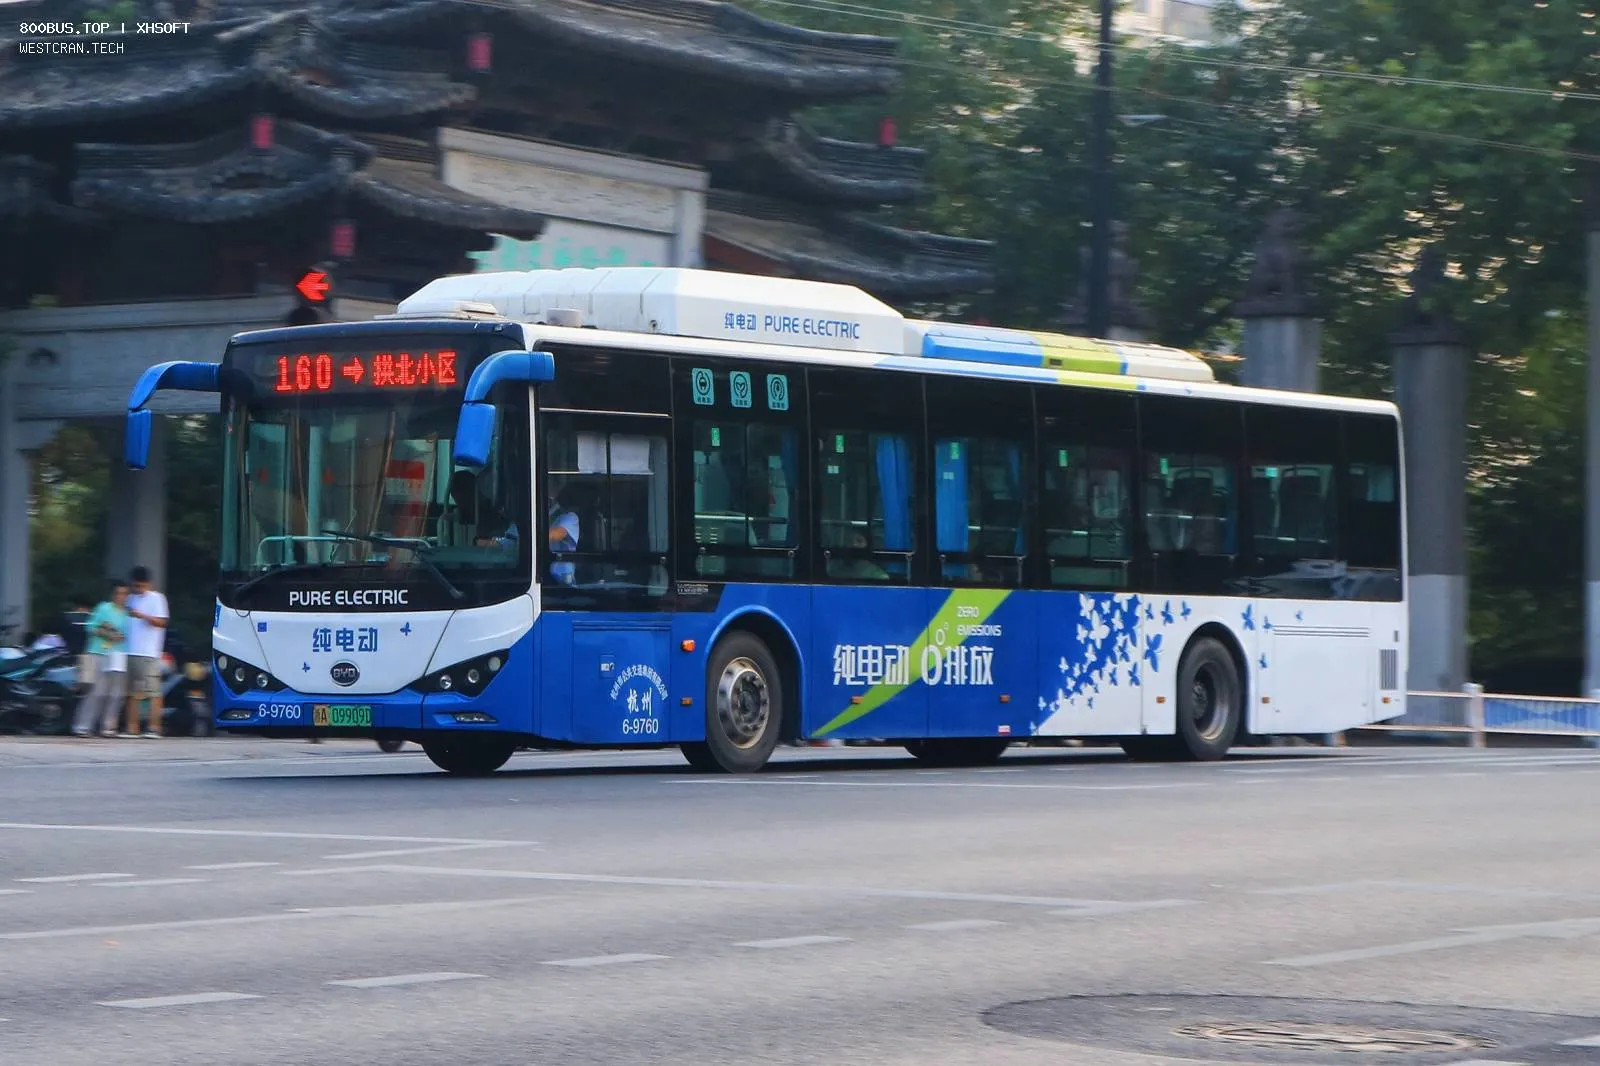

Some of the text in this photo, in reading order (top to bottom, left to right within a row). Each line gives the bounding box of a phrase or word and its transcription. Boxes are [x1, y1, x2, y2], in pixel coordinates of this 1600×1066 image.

[724, 312, 861, 340] 纯电动 PURE ELECTRIC
[276, 352, 457, 391] 160 拱北小区
[289, 589, 409, 606] PURE ELECTRIC
[956, 606, 980, 618] ZERO
[956, 624, 1002, 637] EMISSIONS
[312, 627, 378, 653] 纯电动
[333, 668, 356, 678] BYD
[833, 644, 910, 686] 纯电动
[626, 687, 652, 717] 杭州
[258, 703, 301, 719] 6-9760
[622, 718, 659, 734] 6-9760
